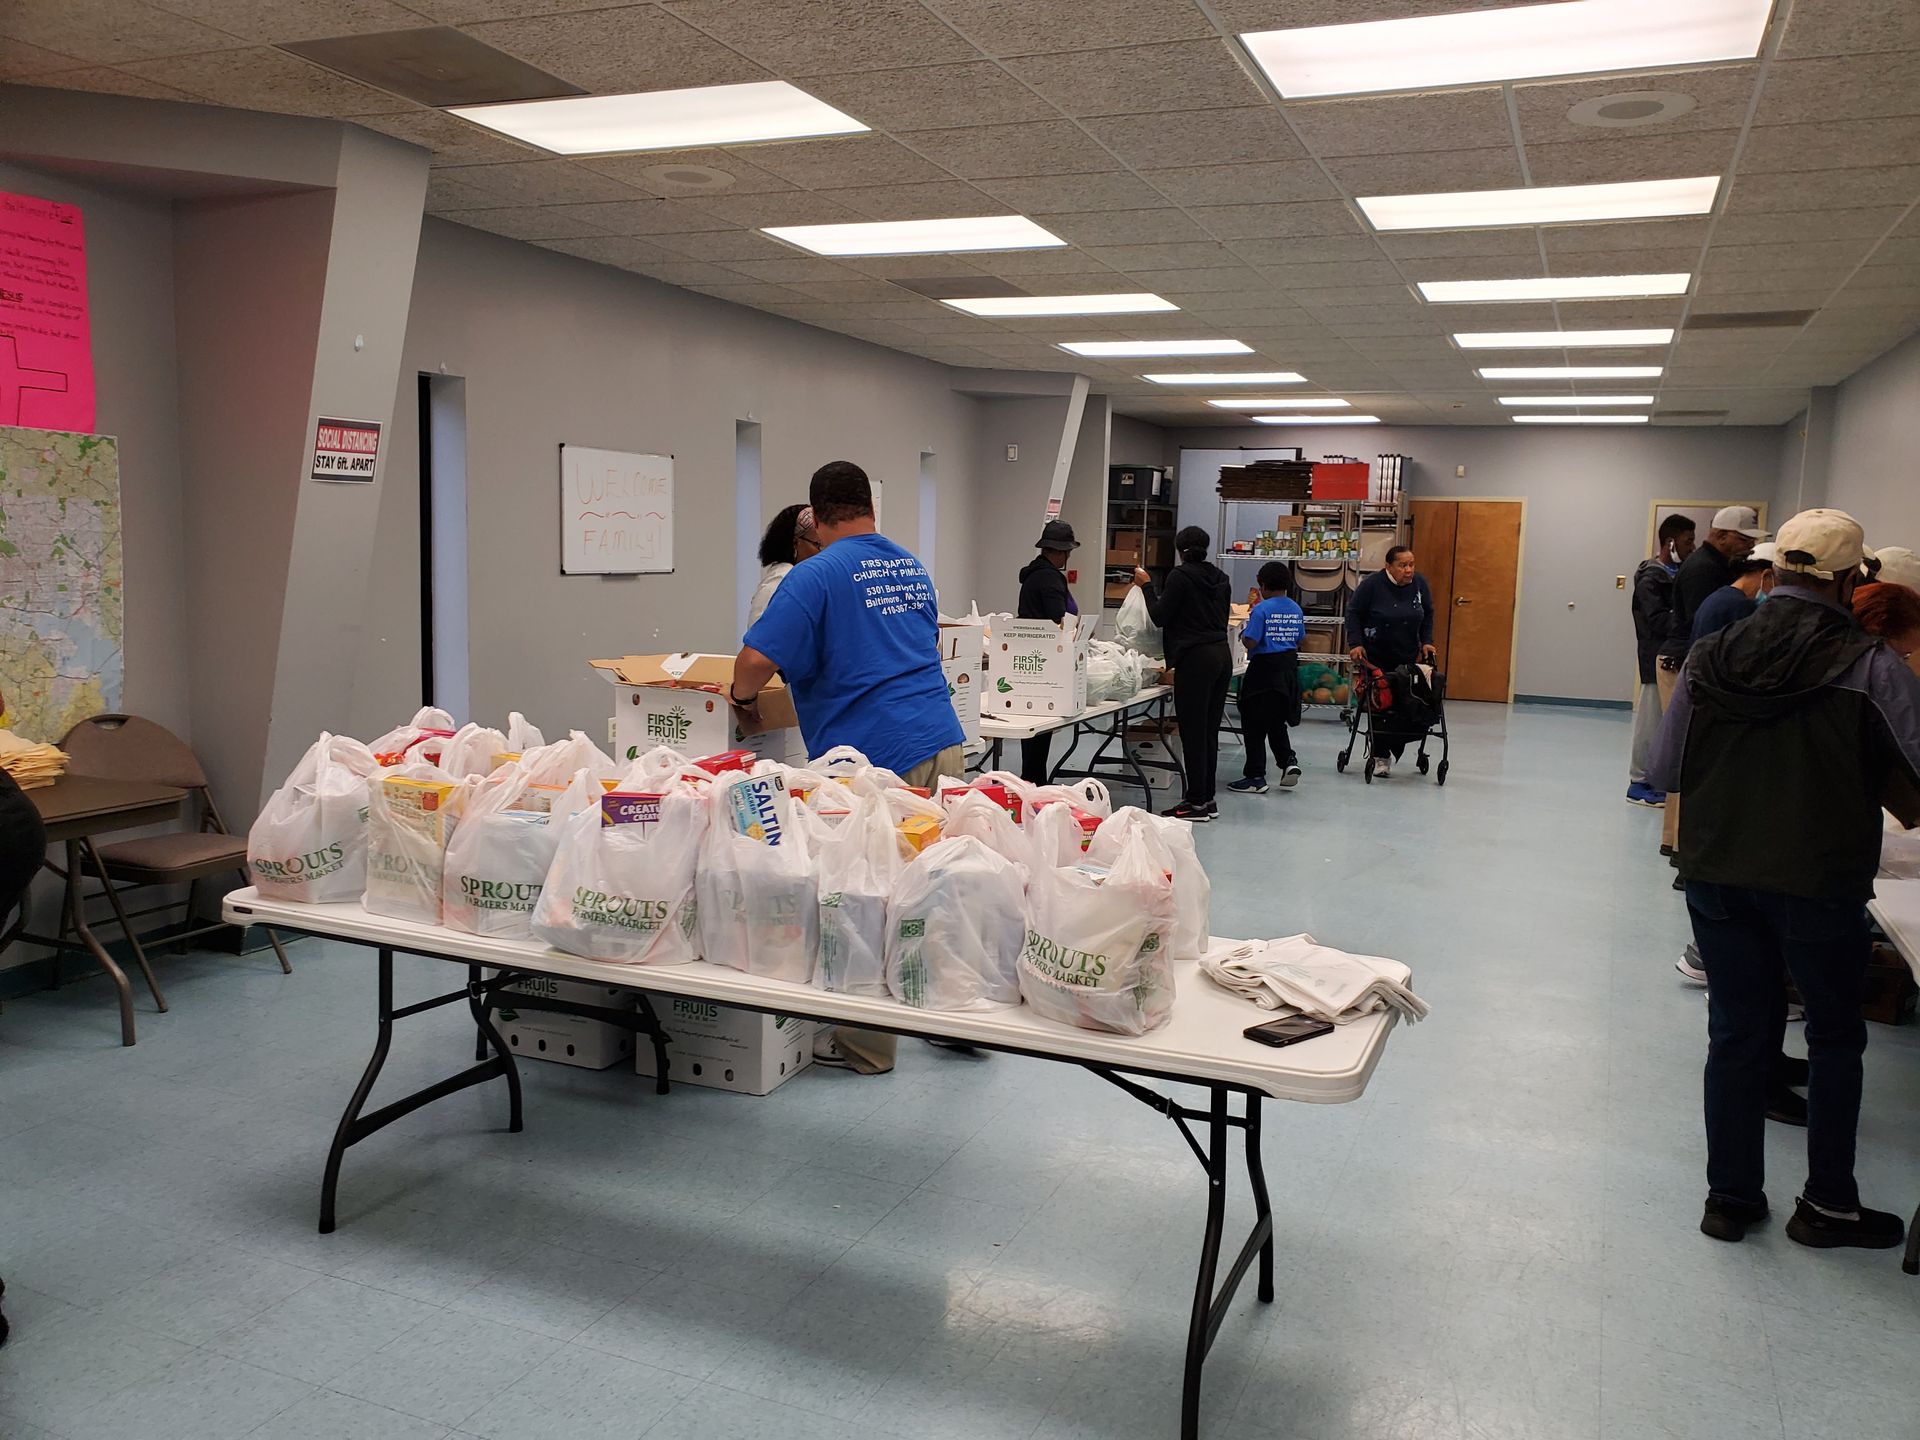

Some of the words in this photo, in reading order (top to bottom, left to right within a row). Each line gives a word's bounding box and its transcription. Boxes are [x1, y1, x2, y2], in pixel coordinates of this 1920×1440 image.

[318, 428, 341, 449] SOCIAL
[342, 431, 378, 452] DISTANCING
[316, 455, 336, 469] STAY
[350, 458, 374, 471] APART
[576, 463, 667, 505] WELCOME
[853, 569, 889, 582] CHURCH
[890, 570, 897, 578] F
[1017, 632, 1056, 640] REFRIGERATED
[1013, 654, 1042, 664] FIRST
[647, 713, 682, 727] FIRST
[655, 737, 679, 745] FARM
[744, 785, 757, 815] CRACKERS
[752, 781, 782, 846] SALTIN
[255, 841, 344, 876] SPROUTS
[305, 860, 345, 881] MARKET
[573, 886, 669, 919] SPROUTS
[613, 917, 663, 931] MARKET
[1027, 930, 1107, 976] SPROUTS
